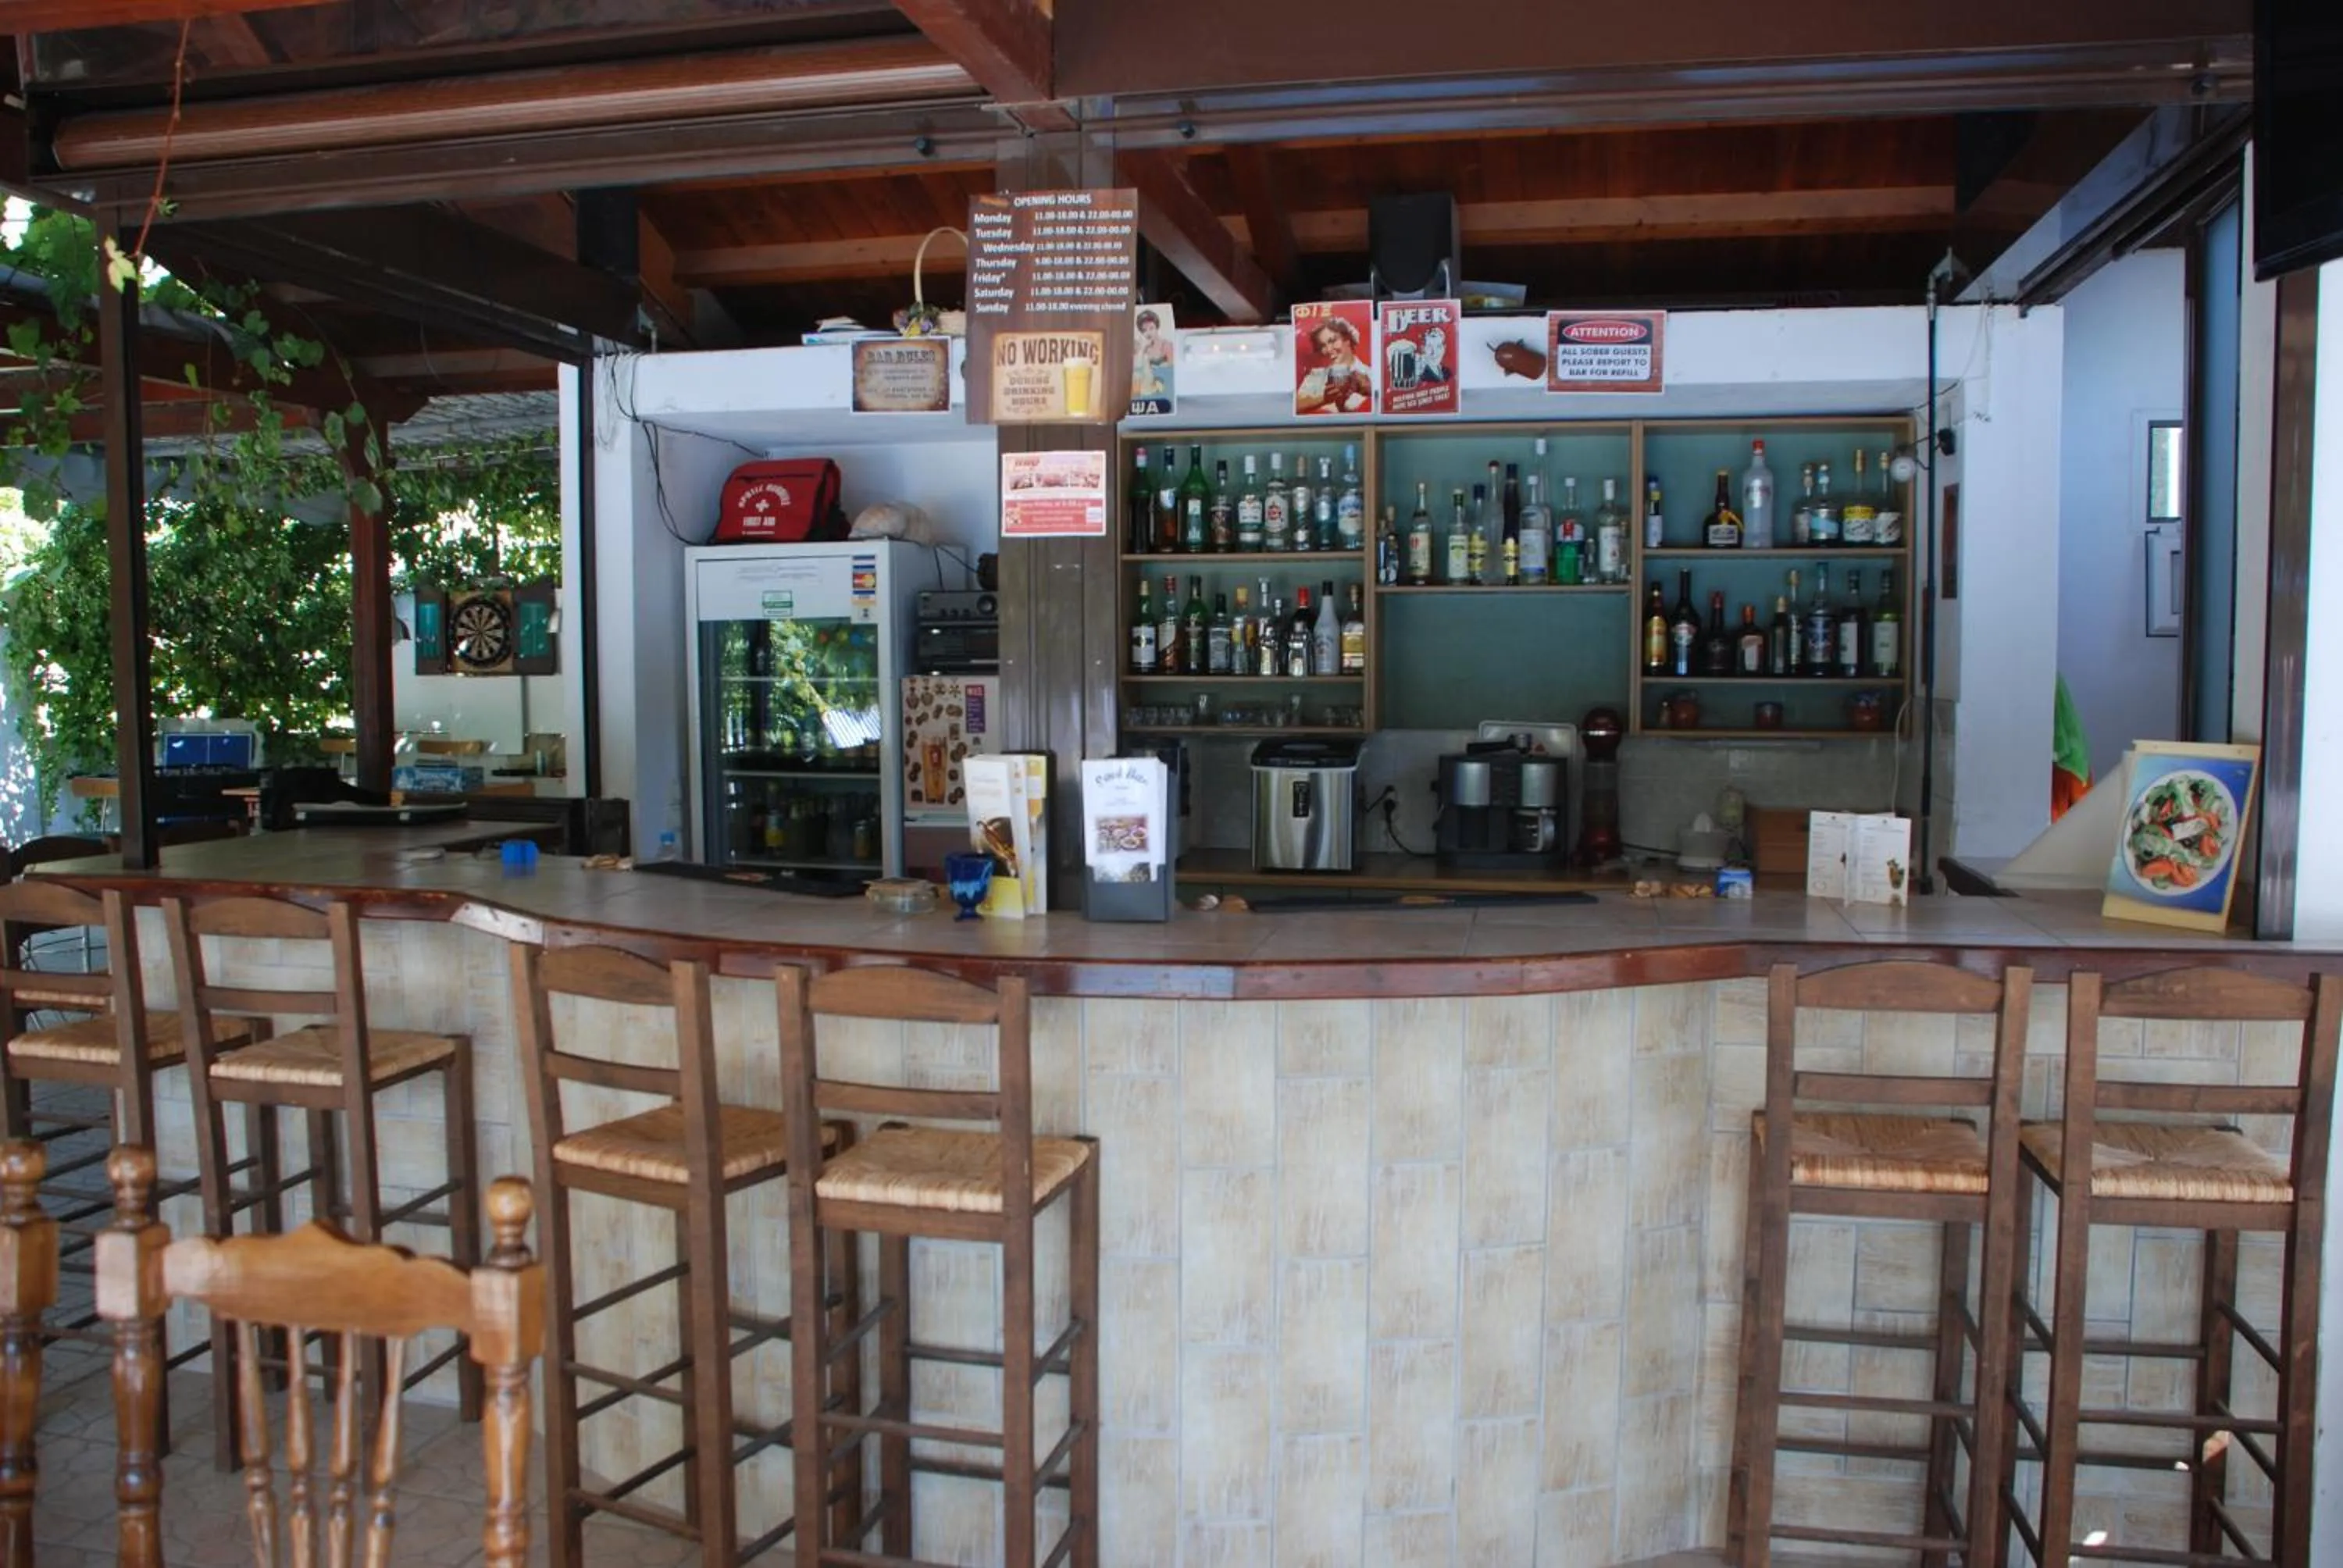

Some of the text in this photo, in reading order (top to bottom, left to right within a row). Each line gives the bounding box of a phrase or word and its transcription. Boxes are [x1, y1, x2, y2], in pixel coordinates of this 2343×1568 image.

[1014, 193, 1092, 207] OPENING HOURS
[974, 212, 1012, 225] Monday
[975, 227, 1012, 240] Tuesday
[982, 241, 1035, 254] Wednesday
[975, 257, 1017, 269] Thursday
[974, 287, 1015, 299] Saturday
[975, 302, 1009, 314] Sunday
[1387, 307, 1453, 334] BEER
[1571, 326, 1639, 338] ATTENTION
[997, 337, 1099, 366] NO WORKING
[1562, 347, 1648, 357] ALL SOBER GUESTS
[1562, 358, 1594, 367] PLEASE
[1635, 358, 1647, 367] TO
[1569, 369, 1639, 377] BAR FOR REFILL
